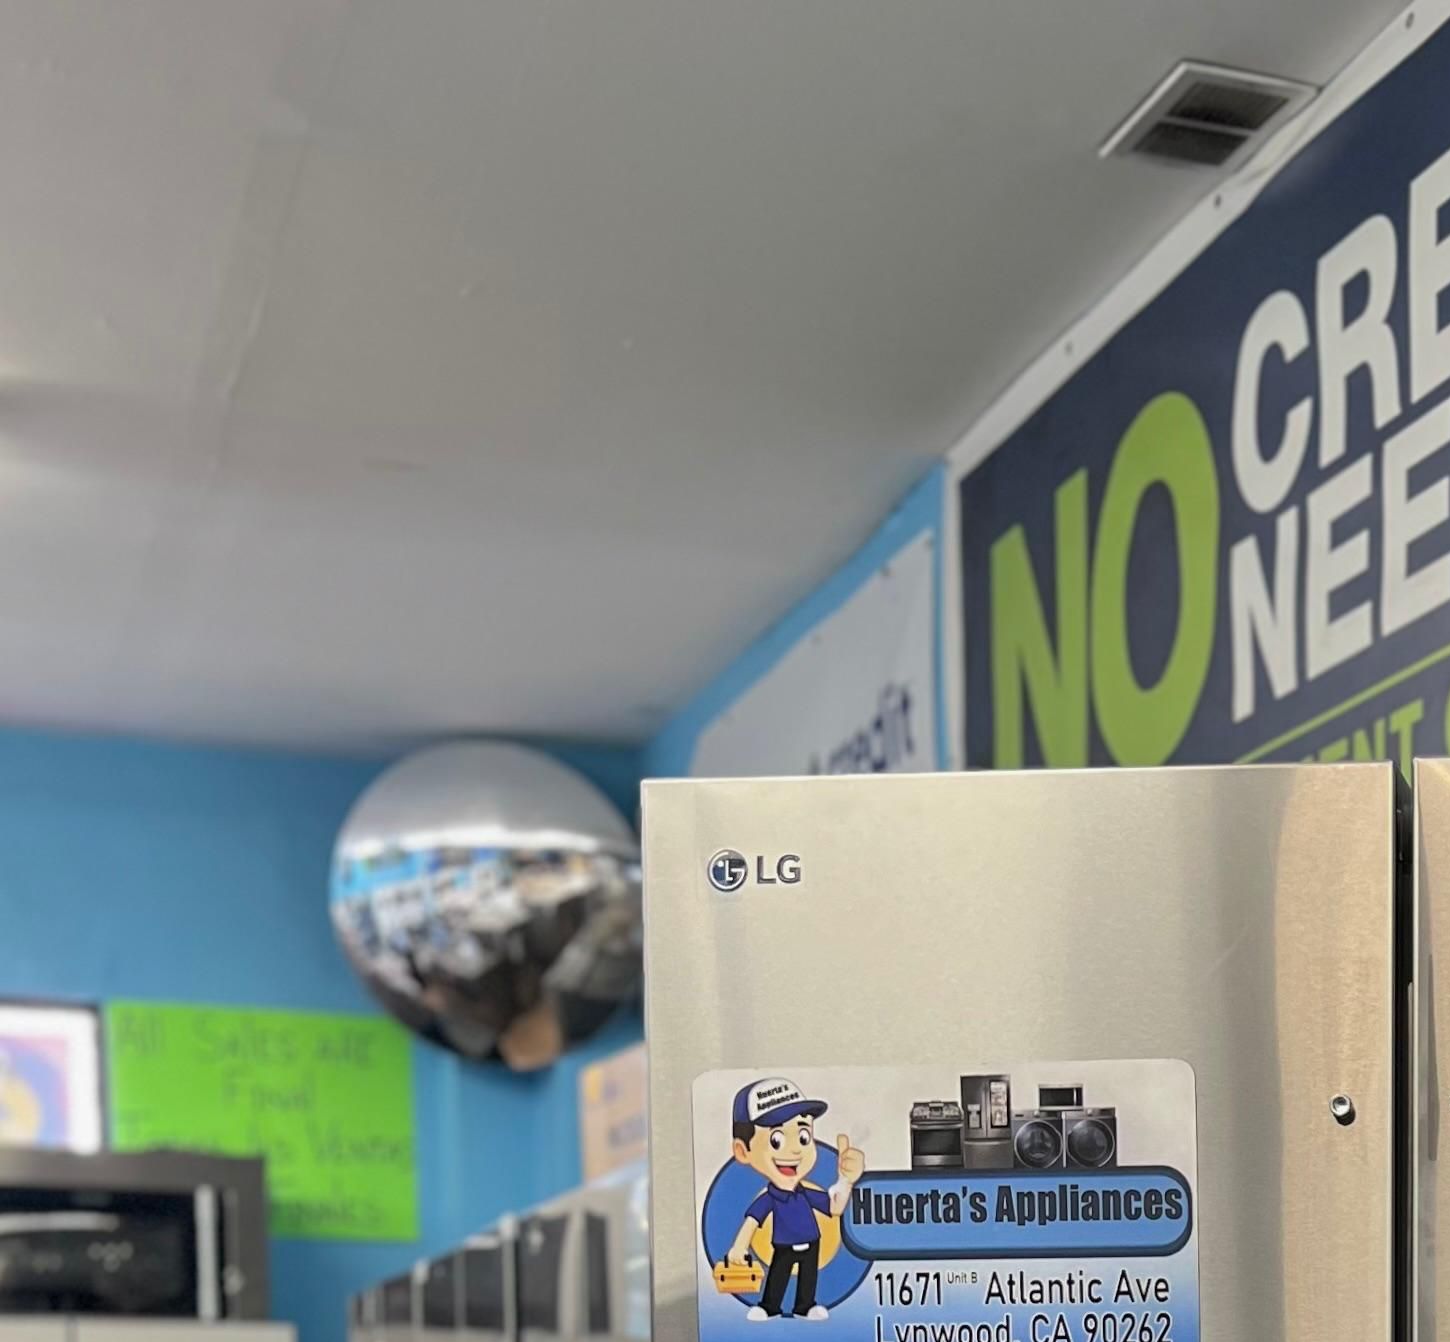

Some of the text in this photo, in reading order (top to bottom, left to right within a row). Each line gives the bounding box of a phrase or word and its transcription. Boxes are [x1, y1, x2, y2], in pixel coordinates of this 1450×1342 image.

[989, 391, 1220, 768] NO
[756, 855, 802, 885] LG
[852, 1184, 1184, 1226] Huerta's Appliances
[874, 1269, 1170, 1306] 11671 Unit B Atlantic Ave
